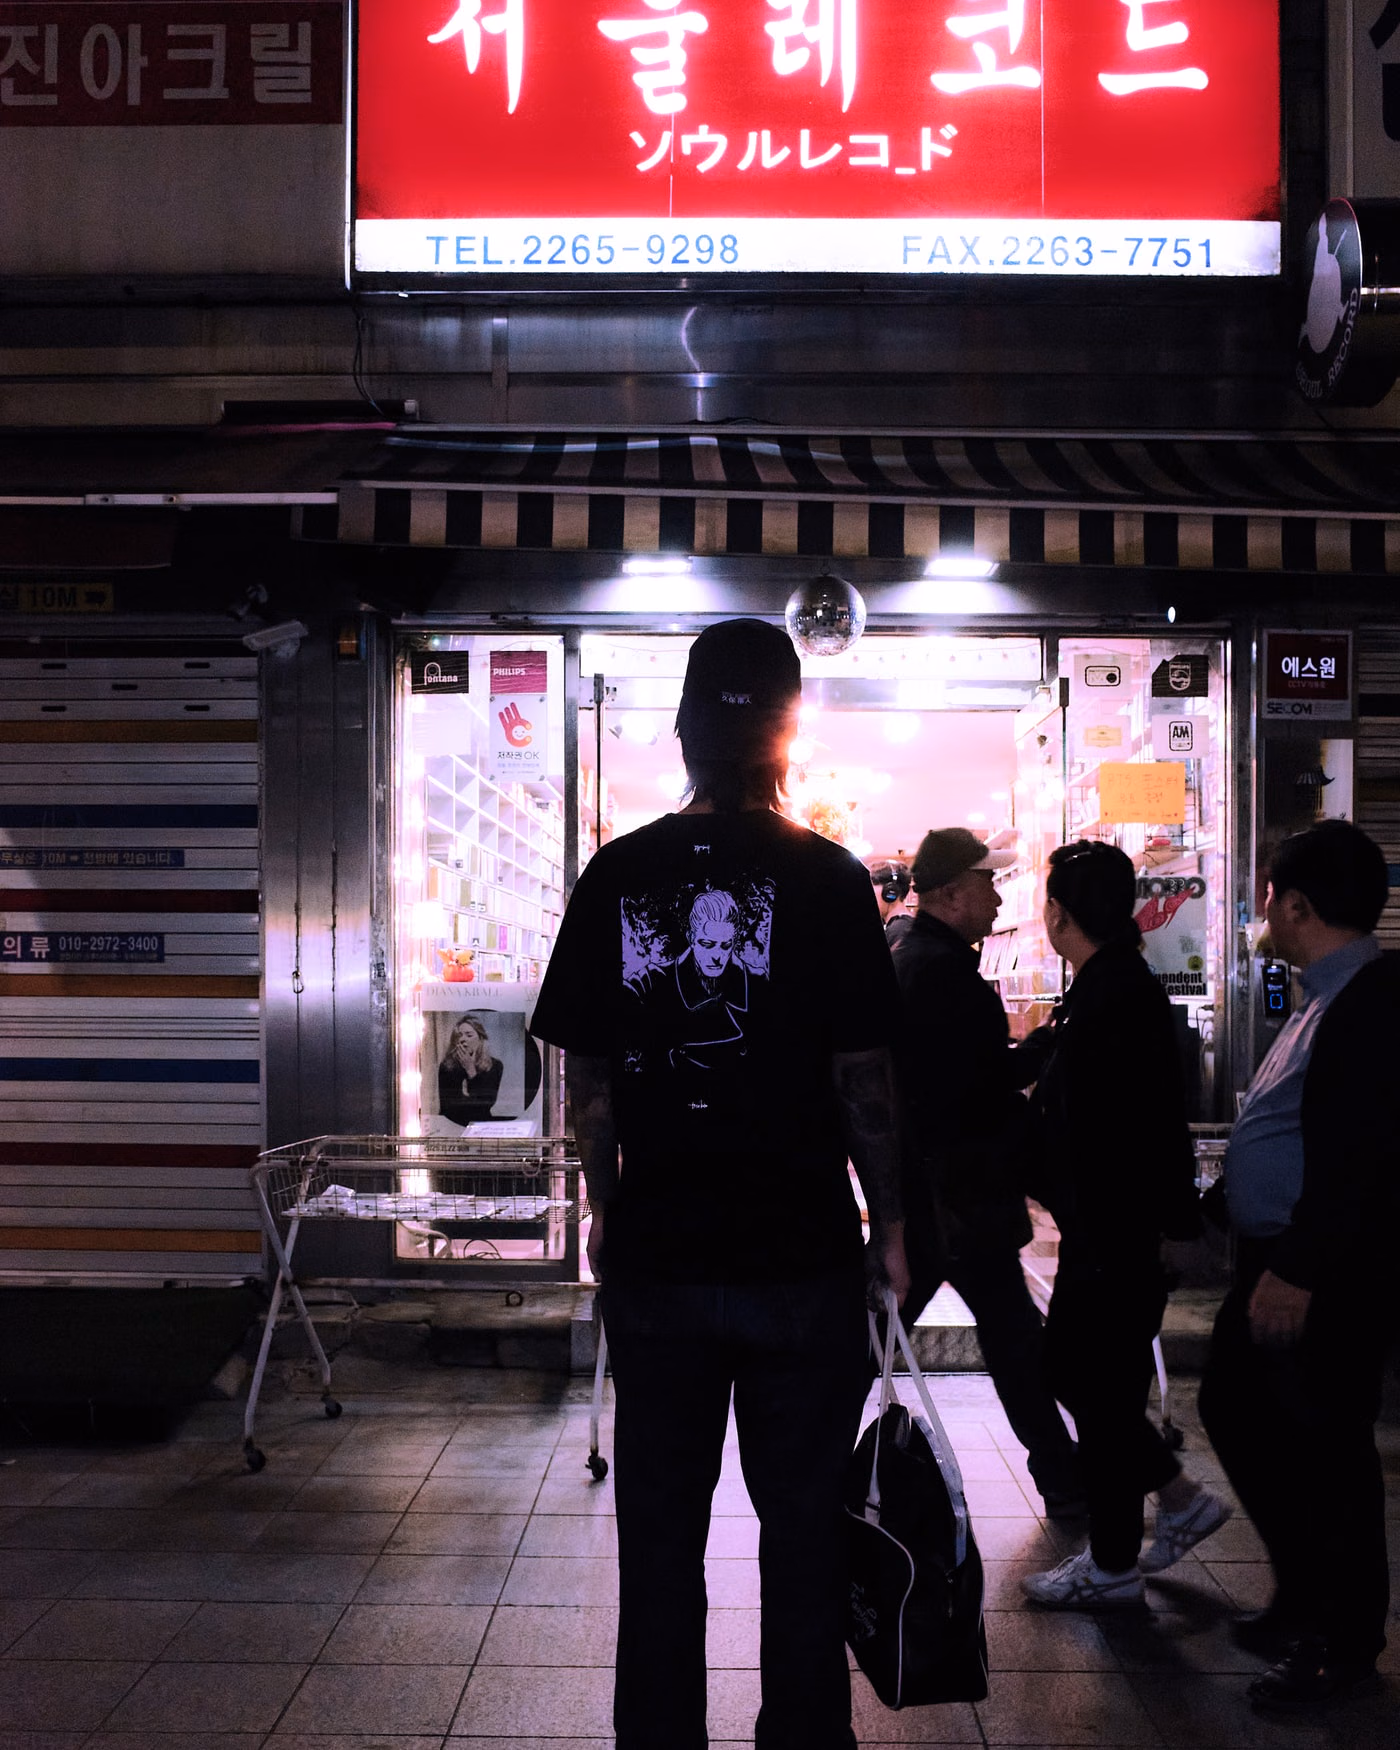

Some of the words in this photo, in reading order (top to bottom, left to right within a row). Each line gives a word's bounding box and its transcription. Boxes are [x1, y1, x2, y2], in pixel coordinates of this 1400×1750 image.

[0, 22, 312, 105] 진아크릴
[426, 234, 740, 266] TEL.2265-9298
[902, 235, 1213, 268] FAX.2263-7751
[493, 667, 526, 676] PHILIPS
[1281, 656, 1336, 679] 에스원
[1266, 702, 1313, 714] SECOM
[524, 751, 540, 760] OK
[58, 936, 159, 951] 010-2972-3400
